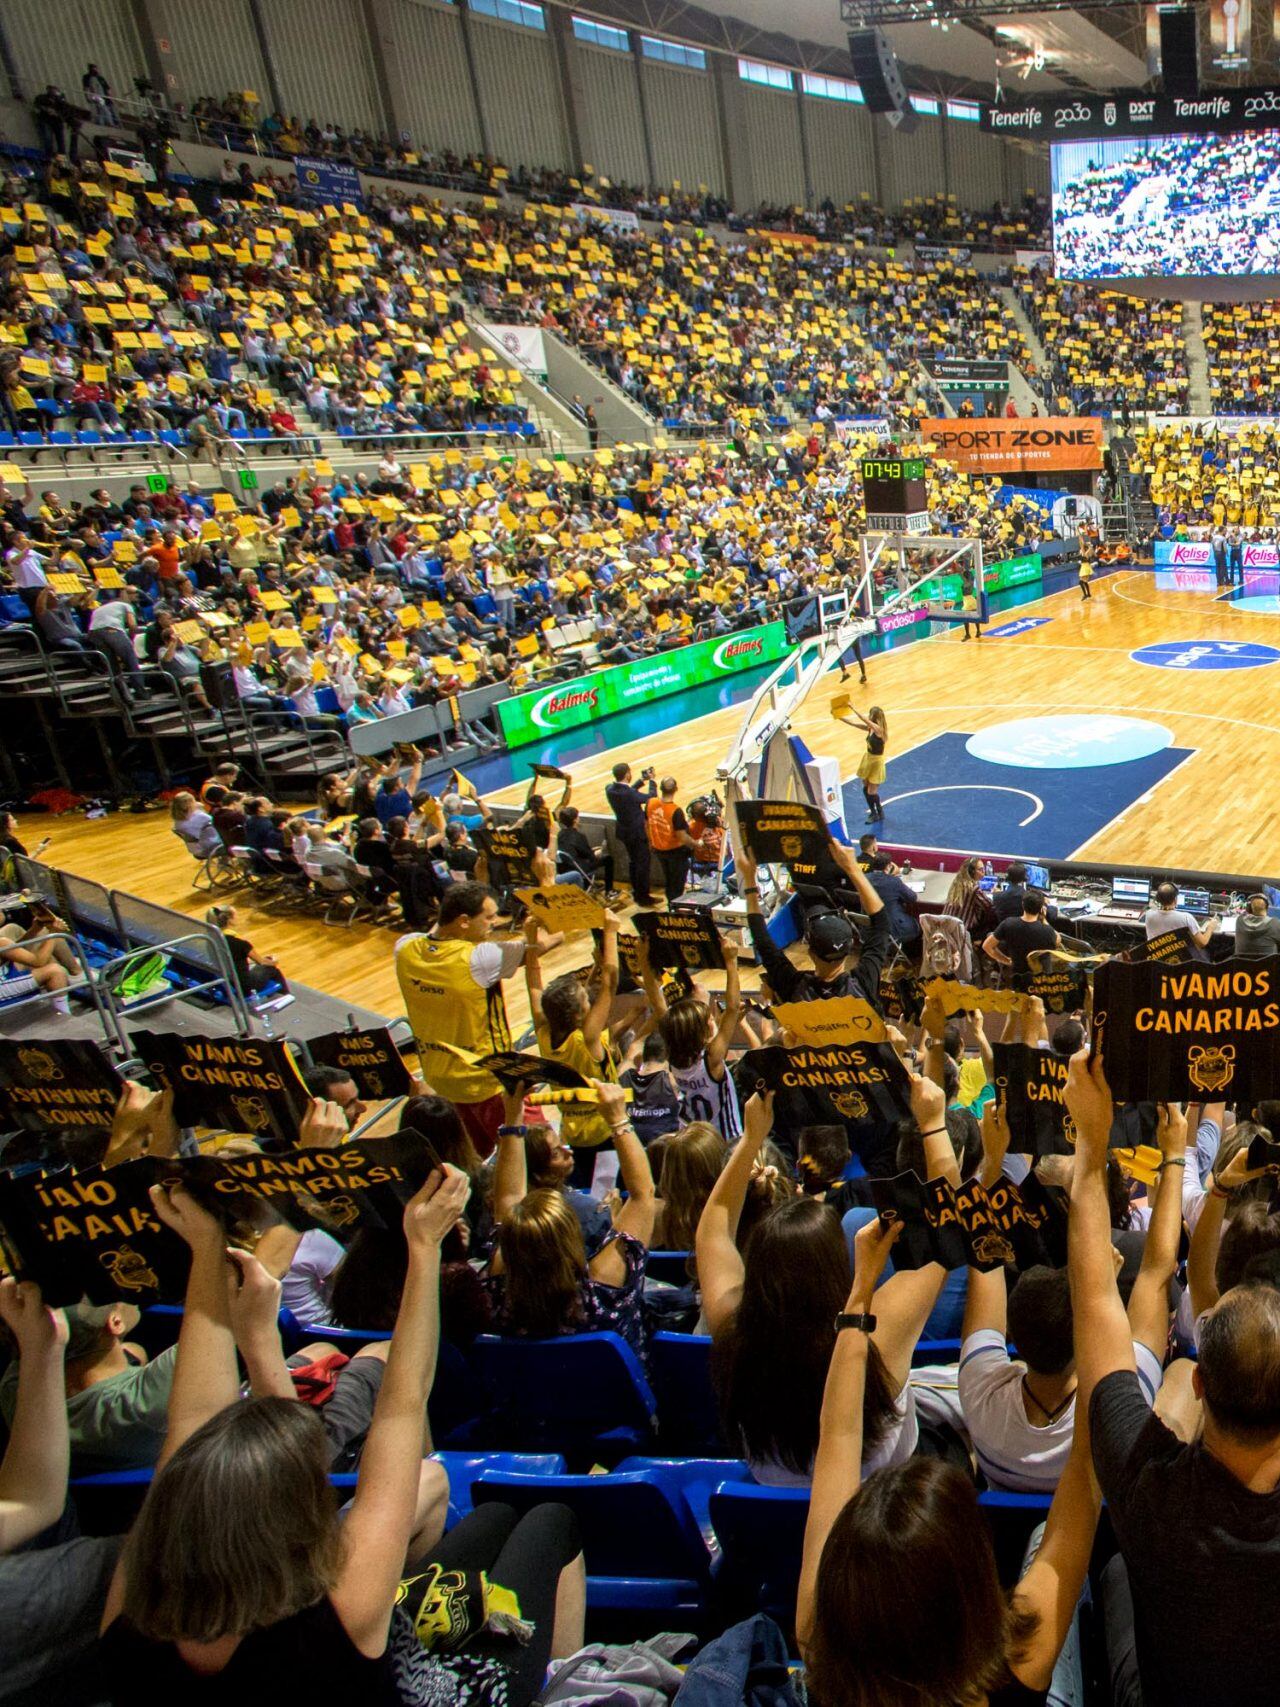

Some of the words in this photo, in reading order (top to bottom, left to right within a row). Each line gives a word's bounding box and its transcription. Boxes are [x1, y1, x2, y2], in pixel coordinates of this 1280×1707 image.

[989, 107, 1042, 128] Tenerife
[1129, 101, 1155, 114] DXT
[1173, 96, 1230, 119] Tenerife
[930, 431, 1004, 449] SPORT
[1011, 429, 1095, 447] ZONE
[970, 453, 979, 461] TU
[979, 453, 1004, 461] TIENDA
[865, 462, 901, 479] 07:43
[1172, 544, 1209, 564] Kalise
[1243, 544, 1280, 566] Kalise
[882, 613, 916, 632] endesa
[725, 637, 763, 659] Balmes
[547, 687, 598, 715] Balmes
[793, 863, 817, 874] STAFF
[1160, 970, 1271, 1001] ¡VAMOS
[782, 1067, 890, 1088] CANARIAS!
[213, 1165, 404, 1198] CANARIAS!
